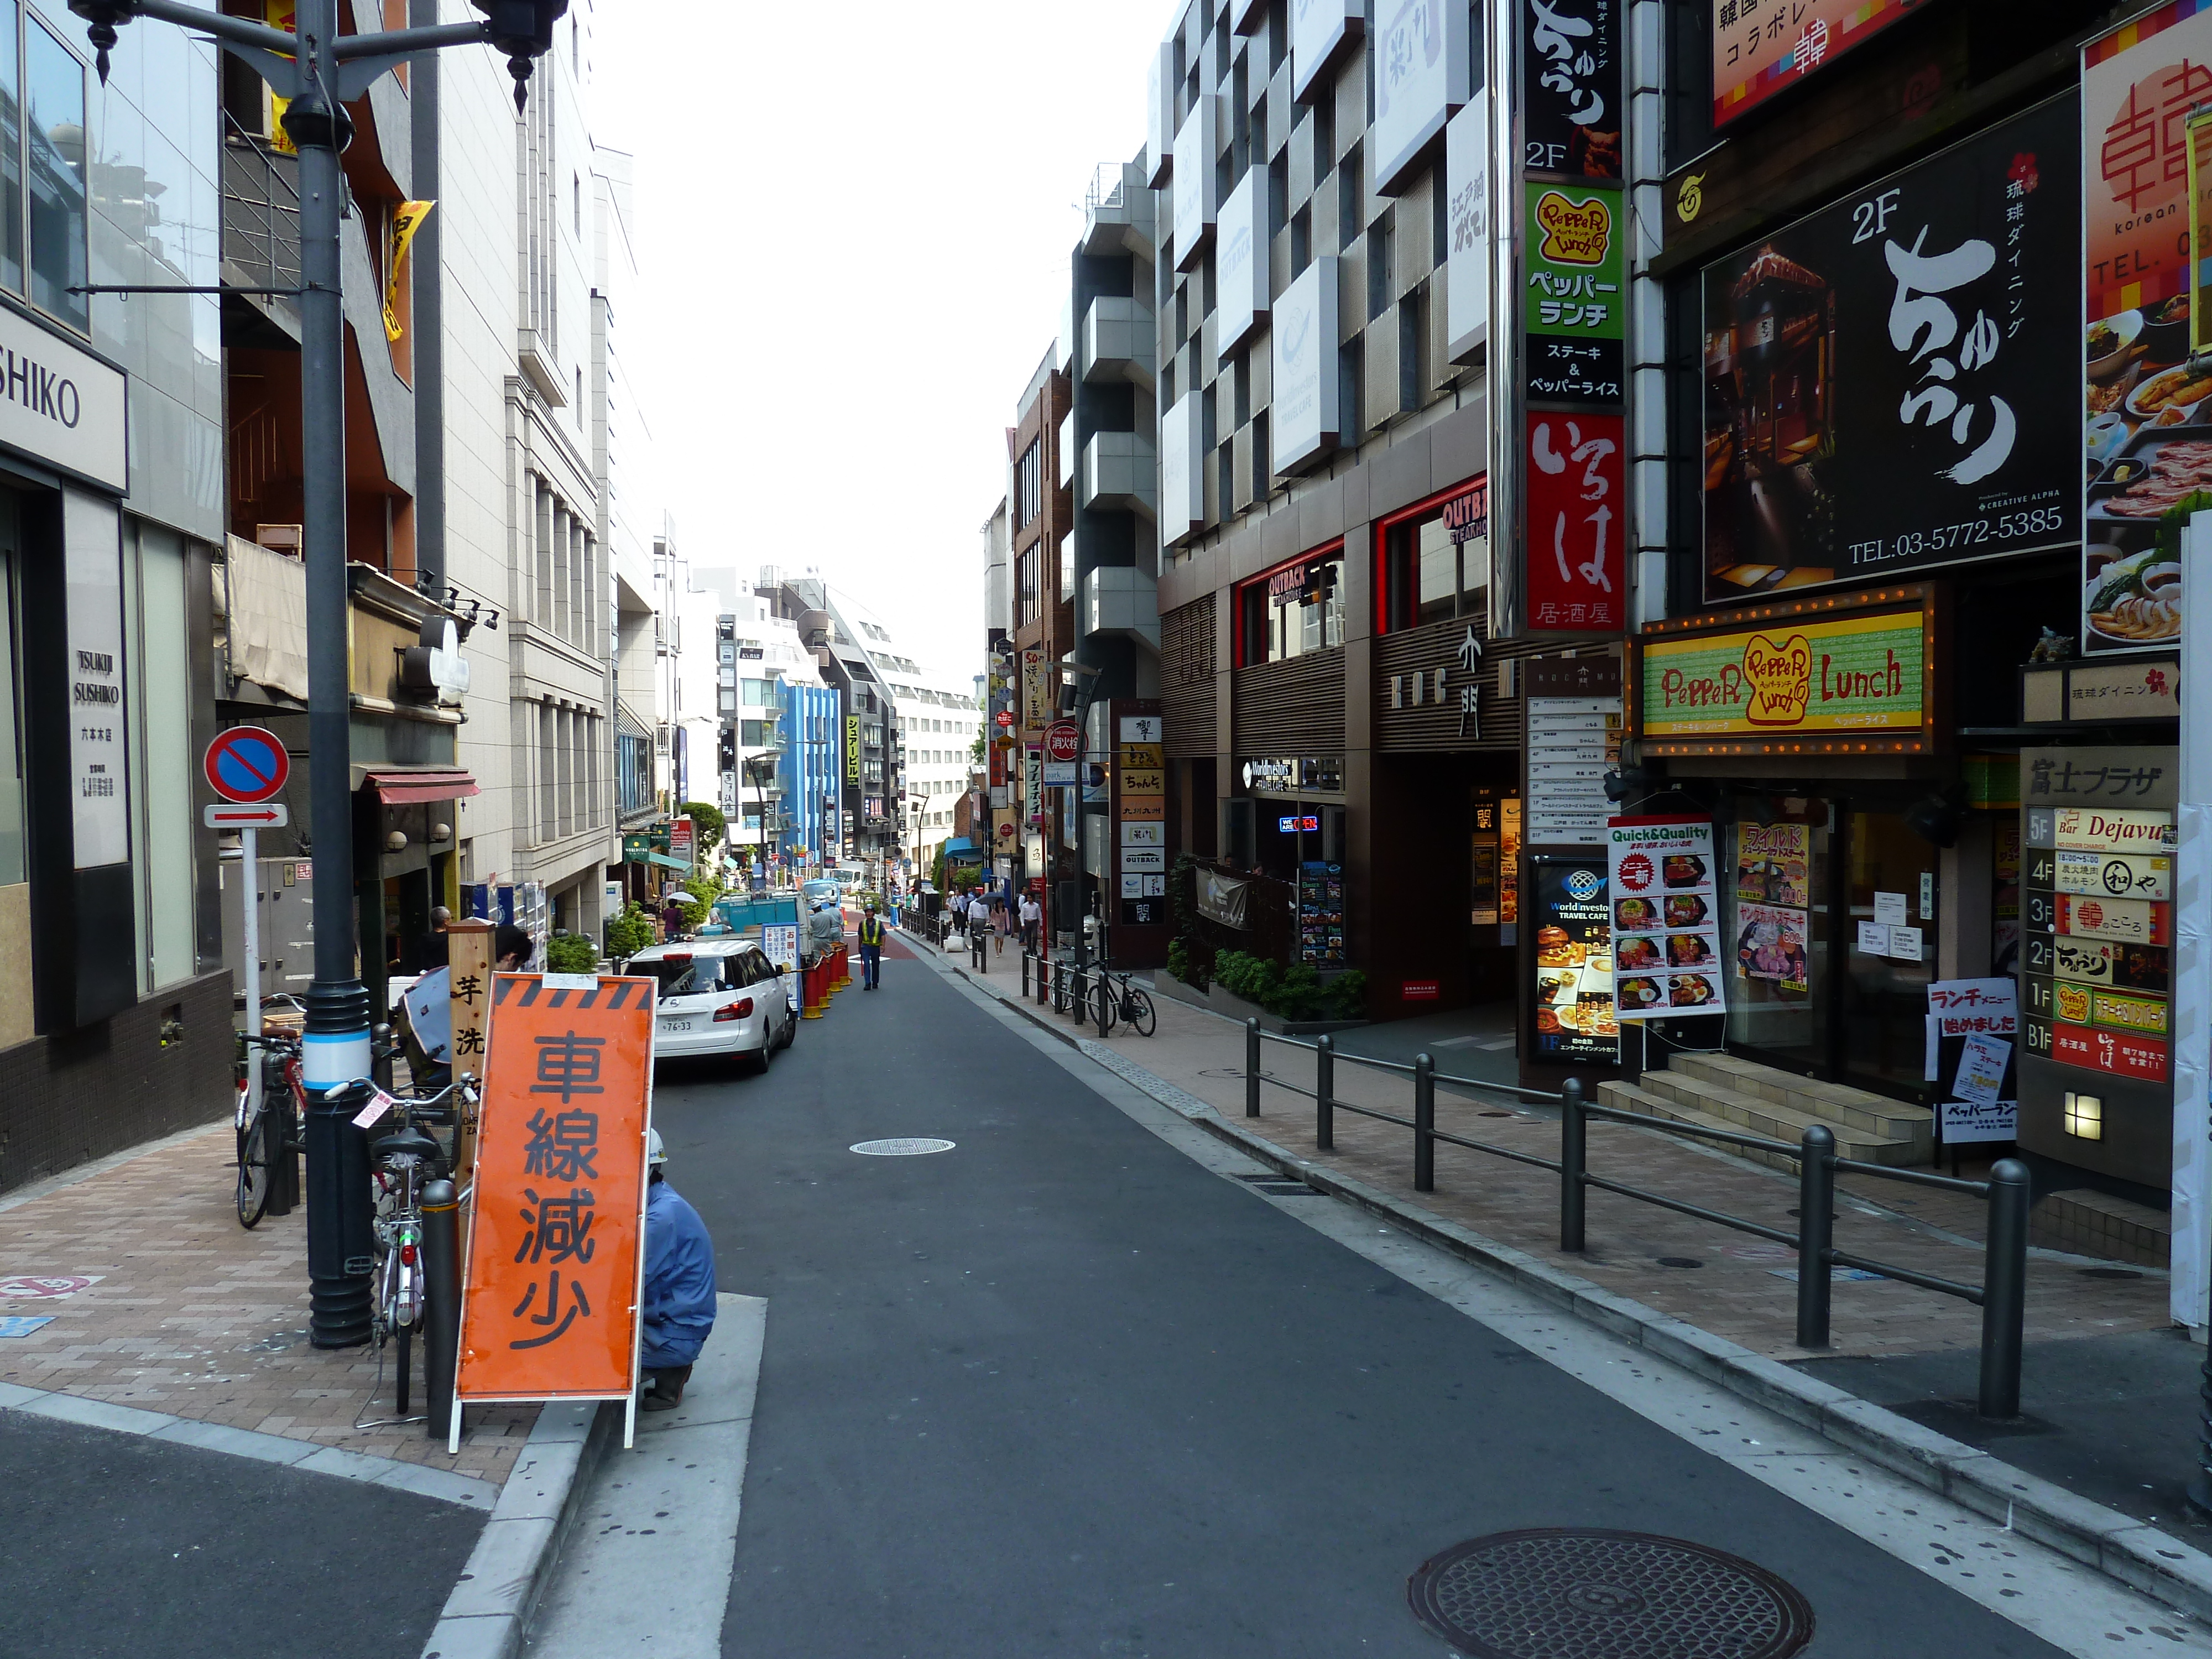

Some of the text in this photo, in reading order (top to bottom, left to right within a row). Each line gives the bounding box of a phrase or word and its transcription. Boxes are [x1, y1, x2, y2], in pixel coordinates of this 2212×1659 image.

[1727, 0, 1820, 66] コラボレ
[1526, 142, 1567, 168] 2F
[1853, 188, 1901, 243] 2F
[1454, 209, 1486, 253] がって
[2006, 179, 2025, 340] 琉球ダイニング
[2094, 248, 2160, 285] TEL.
[1530, 271, 1618, 299] ペッパー
[1540, 300, 1608, 327] ランチ
[1548, 345, 1601, 360] ステーキ
[1569, 363, 1580, 377] &
[1530, 378, 1619, 397] ペッパーライス
[1987, 489, 2060, 510] CREATIVE ALPHA
[1268, 565, 1305, 597] OUTBACK
[1272, 587, 1302, 608] STEAKHOUSE
[1536, 602, 1613, 625] 居酒屋
[77, 650, 113, 676] TSUKIJI
[1822, 649, 1902, 702] Lunch
[75, 683, 119, 704] SUSHIKO
[81, 727, 112, 742] 六本木店
[1052, 737, 1078, 750] 消火栓
[848, 719, 858, 776] シュアービル
[1125, 775, 1160, 790] ちゃんと。
[1612, 826, 1708, 842] Quick&Quality
[1746, 826, 1802, 848] ワイルド
[2031, 815, 2048, 840] 5F
[2059, 816, 2163, 843] Bar Dejavu
[1622, 870, 1649, 885] 一新
[1623, 863, 1650, 871] メニュー
[2031, 859, 2054, 881] 4F
[2062, 865, 2099, 875] 炭火焼肉
[2062, 876, 2099, 886] ホルモン
[2032, 899, 2053, 924] 3F
[2031, 941, 2053, 966] 2F
[1931, 988, 2011, 1009] ランチメニュー
[2032, 982, 2051, 1006] 1F
[667, 1022, 691, 1031] 76-33
[1944, 1016, 2016, 1034] 始めました
[1540, 1035, 1561, 1051] 1F
[2028, 1023, 2053, 1050] B1F
[2059, 1038, 2088, 1053] 居酒屋
[1980, 1055, 2002, 1067] ステーキ
[2122, 1046, 2166, 1062] 朝7時まで
[1948, 1103, 2017, 1117] ペッパーラン
[509, 1029, 607, 1350] 車線減少
